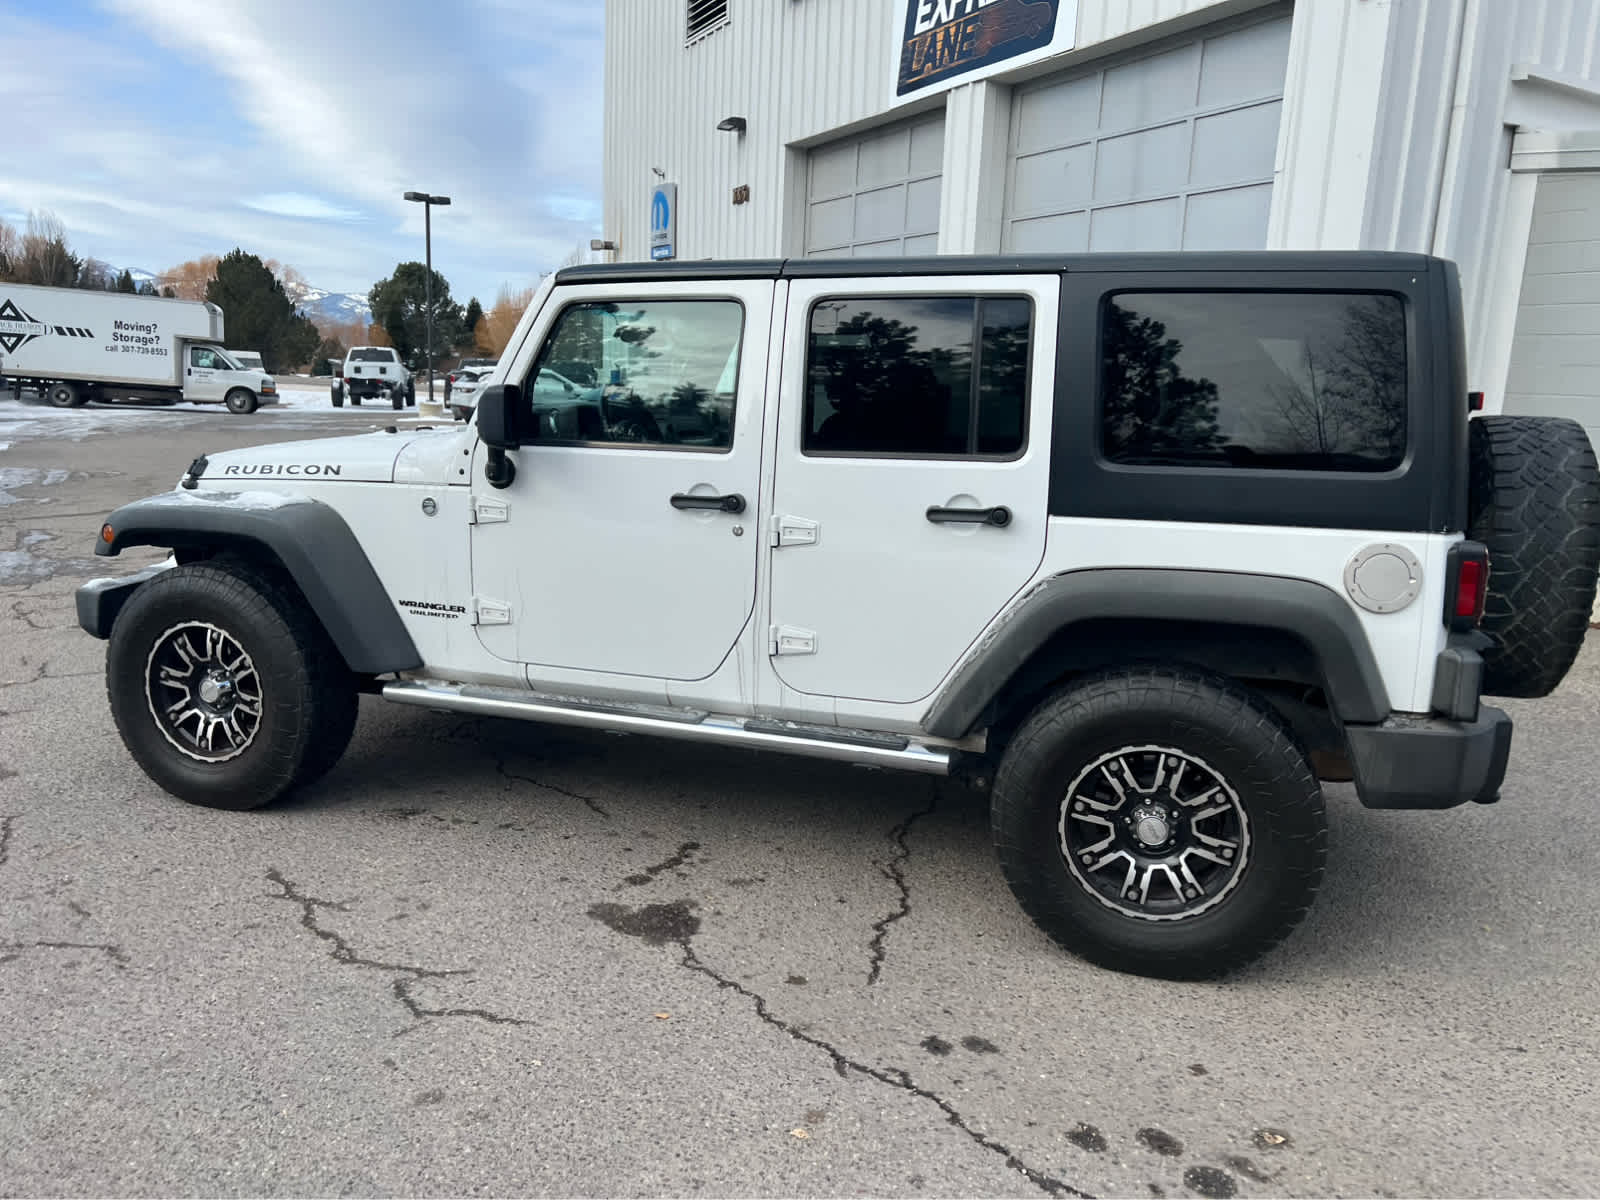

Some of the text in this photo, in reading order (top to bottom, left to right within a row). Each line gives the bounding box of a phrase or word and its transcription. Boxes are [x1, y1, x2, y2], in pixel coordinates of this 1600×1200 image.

[114, 320, 158, 335] Moving?
[112, 333, 160, 347] Storage?
[224, 464, 341, 475] RUBICON
[398, 600, 466, 614] WRANGLER
[409, 609, 459, 619] UNLIMITED
